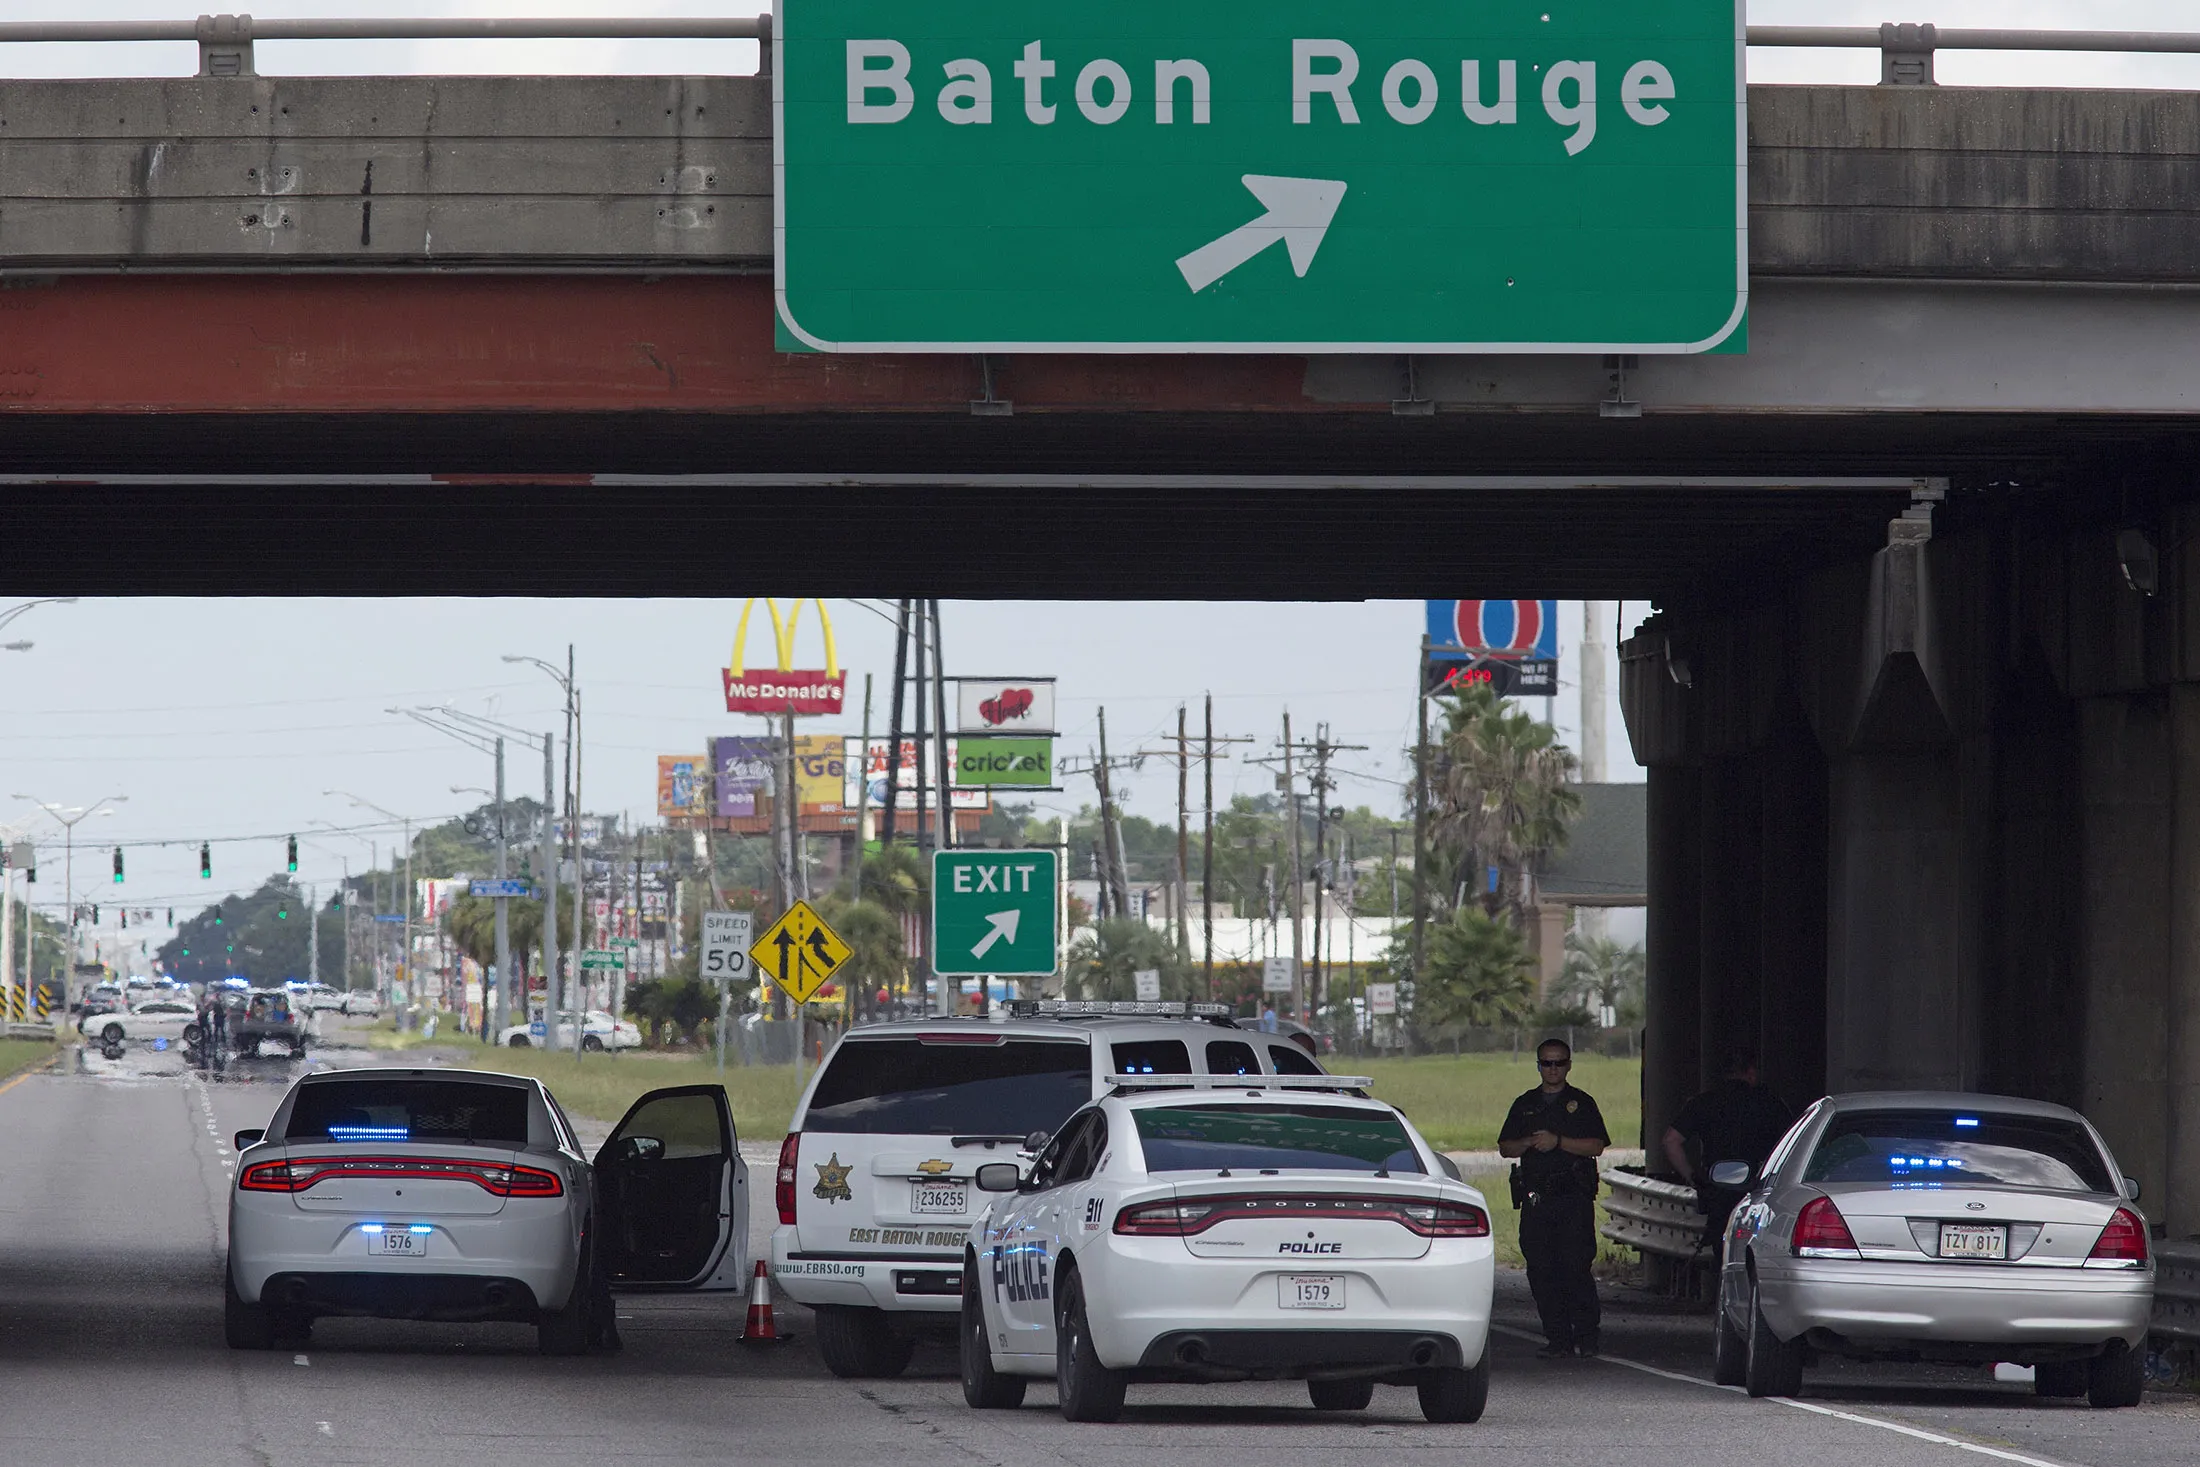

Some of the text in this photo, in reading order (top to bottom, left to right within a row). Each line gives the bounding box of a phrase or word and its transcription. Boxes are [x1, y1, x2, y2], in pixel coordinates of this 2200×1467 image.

[846, 39, 1676, 157] Baton Rouge
[729, 682, 842, 700] McDonald's
[962, 751, 1047, 772] cricket
[953, 865, 1036, 893] EXIT
[706, 918, 749, 929] SPEED
[710, 935, 744, 945] LIMIT
[706, 950, 745, 972] 50
[921, 1191, 964, 1206] 236255
[1246, 1201, 1374, 1209] DODGE
[1085, 1198, 1105, 1223] 911
[384, 1234, 412, 1249] 1576
[849, 1228, 968, 1247] EAST BATON ROUGE
[1945, 1233, 2001, 1251] TZY 817
[1278, 1242, 1343, 1254] POLICE
[773, 1262, 866, 1277] www.EBRSO.org
[992, 1240, 1050, 1303] POLICE
[1297, 1285, 1330, 1301] 1579
